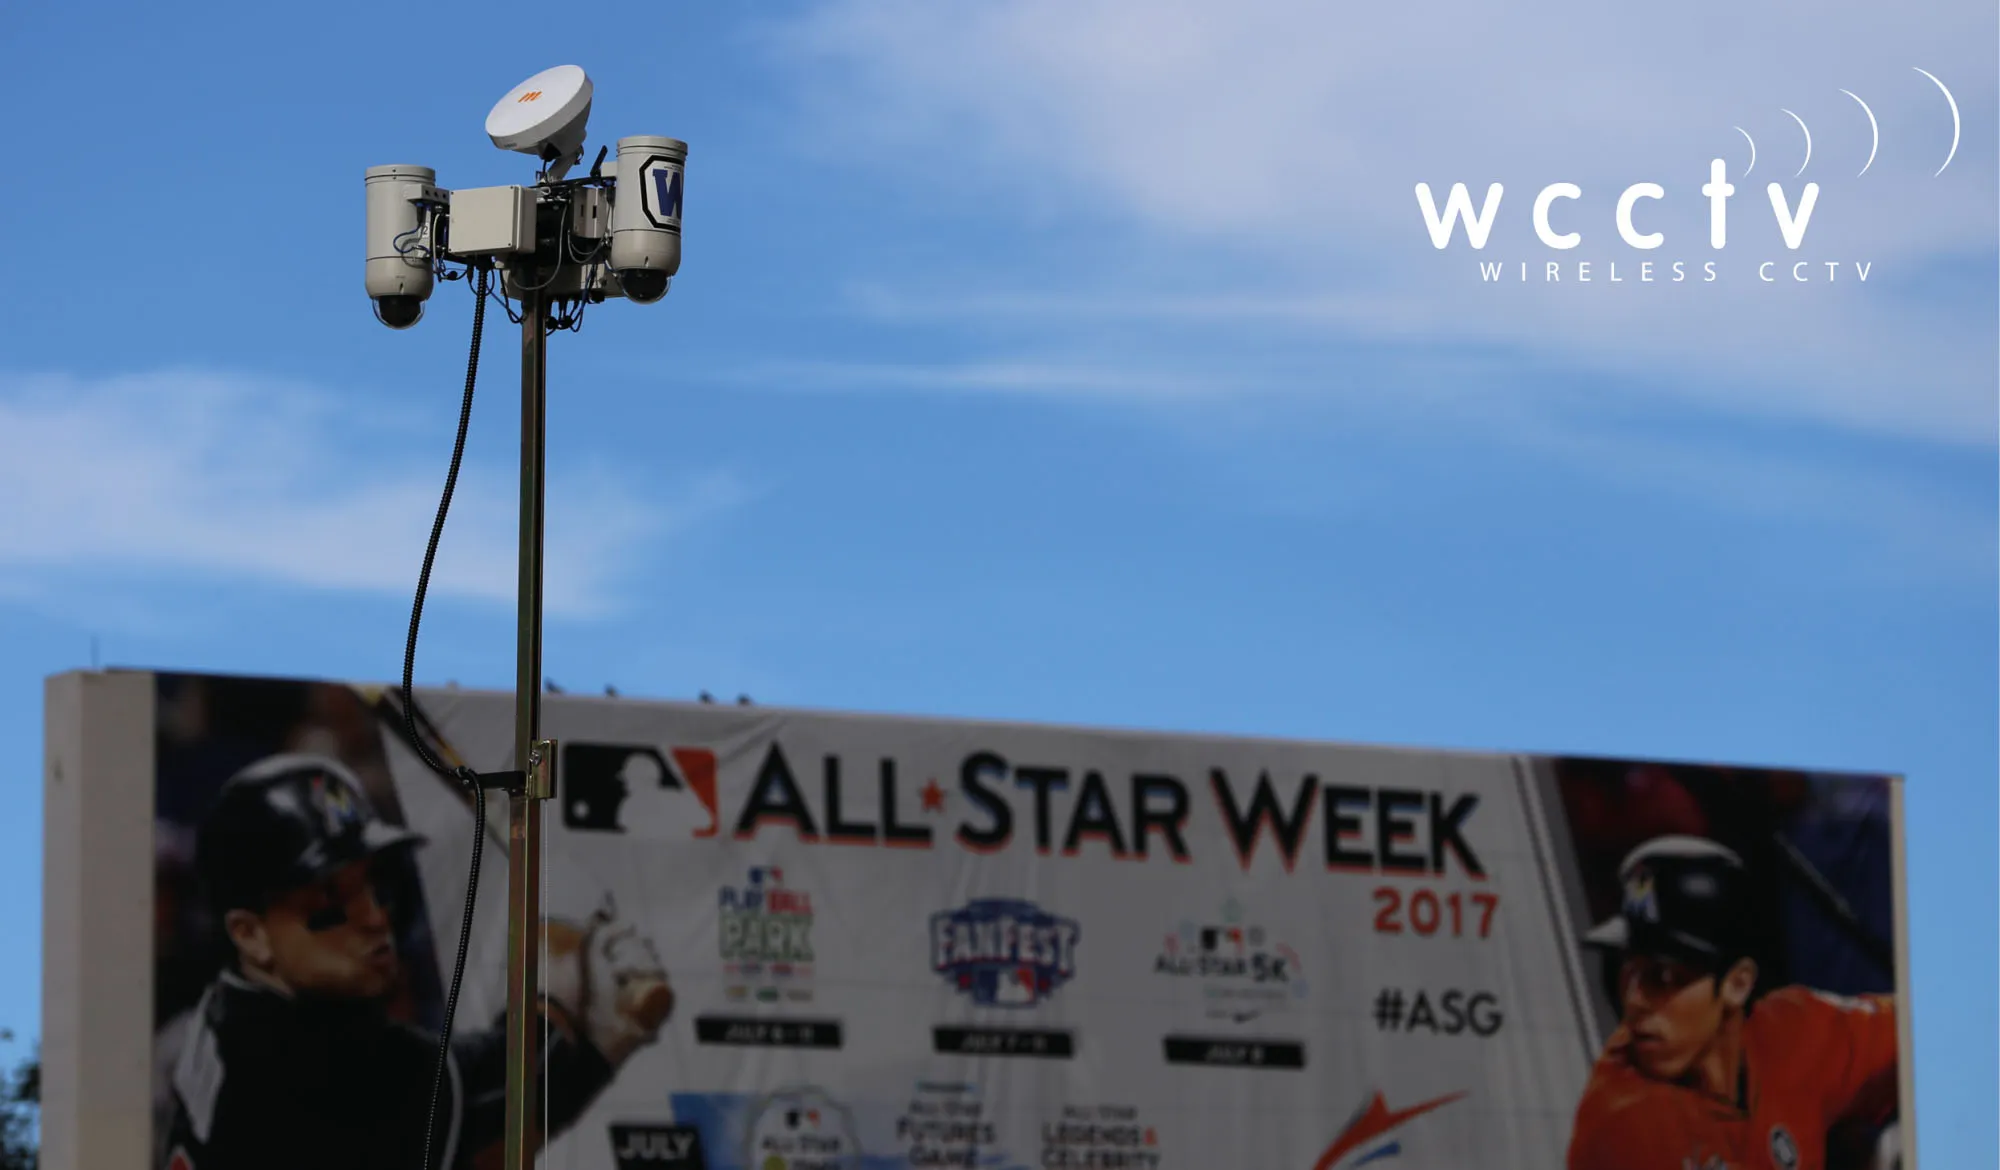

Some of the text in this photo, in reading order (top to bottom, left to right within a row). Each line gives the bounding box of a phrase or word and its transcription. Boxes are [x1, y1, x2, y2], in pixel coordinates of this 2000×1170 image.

[734, 741, 1489, 881] ALL STAR WEEK
[718, 912, 816, 962] PARK
[1371, 886, 1500, 939] 2017
[932, 912, 1079, 977] FANFEST
[1373, 987, 1504, 1036] #ASG
[619, 1132, 694, 1159] JULY
